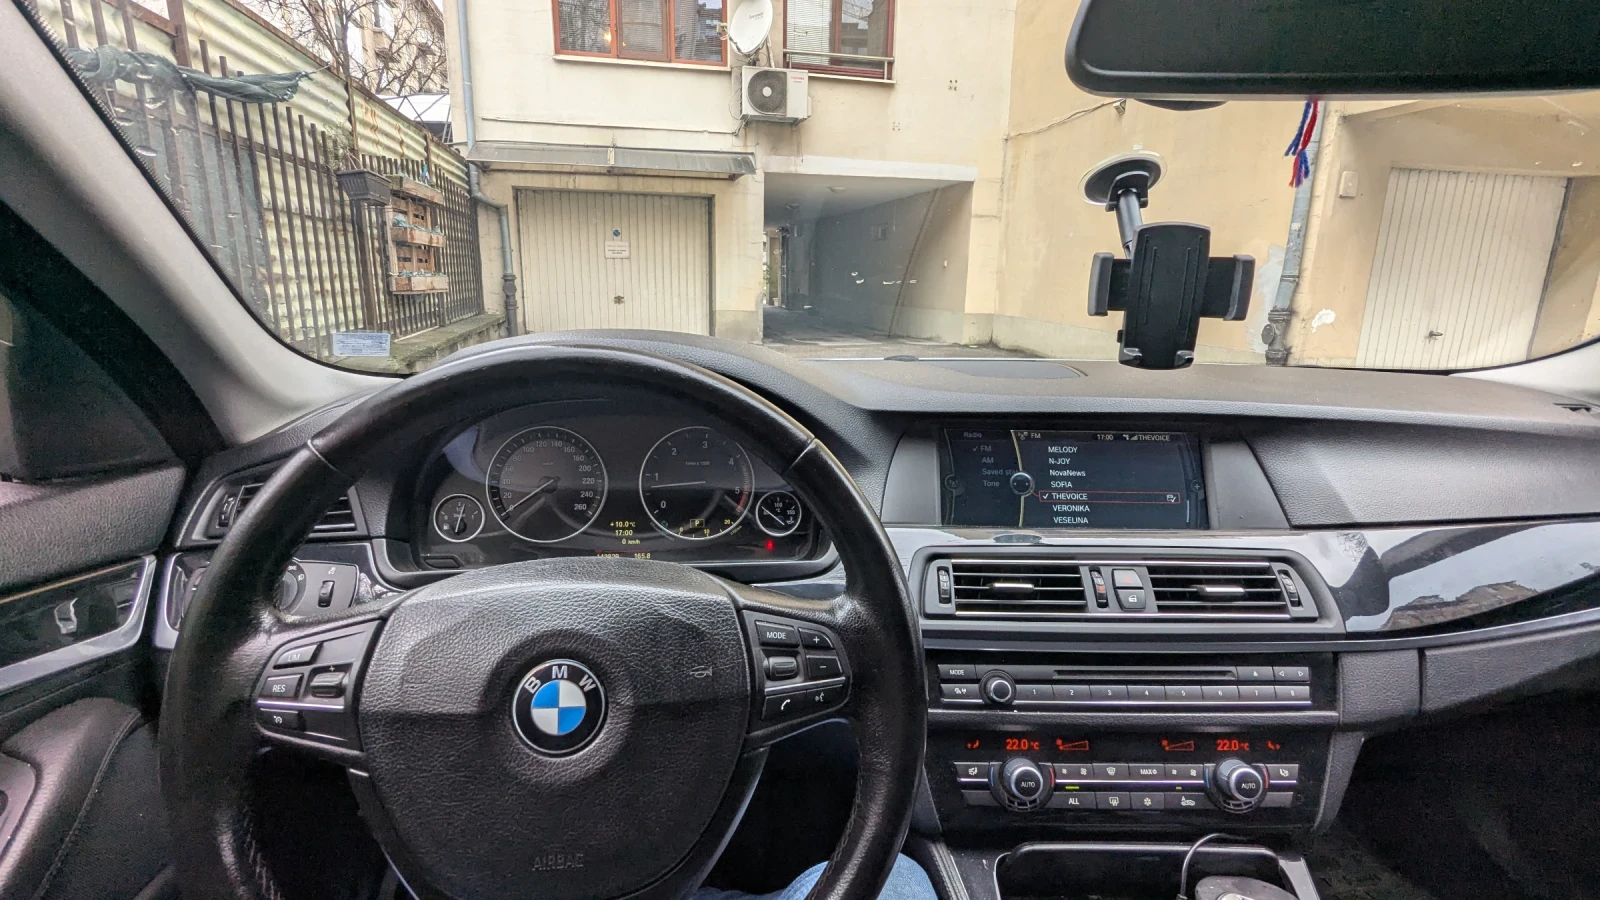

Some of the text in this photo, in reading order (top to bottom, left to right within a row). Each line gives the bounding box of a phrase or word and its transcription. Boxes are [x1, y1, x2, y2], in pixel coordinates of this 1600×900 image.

[702, 441, 708, 449] 3
[1049, 469, 1086, 477] NovaNews
[1052, 492, 1088, 500] THEVOICE
[766, 631, 787, 640] MODE
[288, 654, 301, 662] LIM
[523, 665, 597, 695] BMW
[272, 685, 286, 693] RES
[1006, 739, 1028, 750] 22.0
[1217, 740, 1239, 751] 22.0
